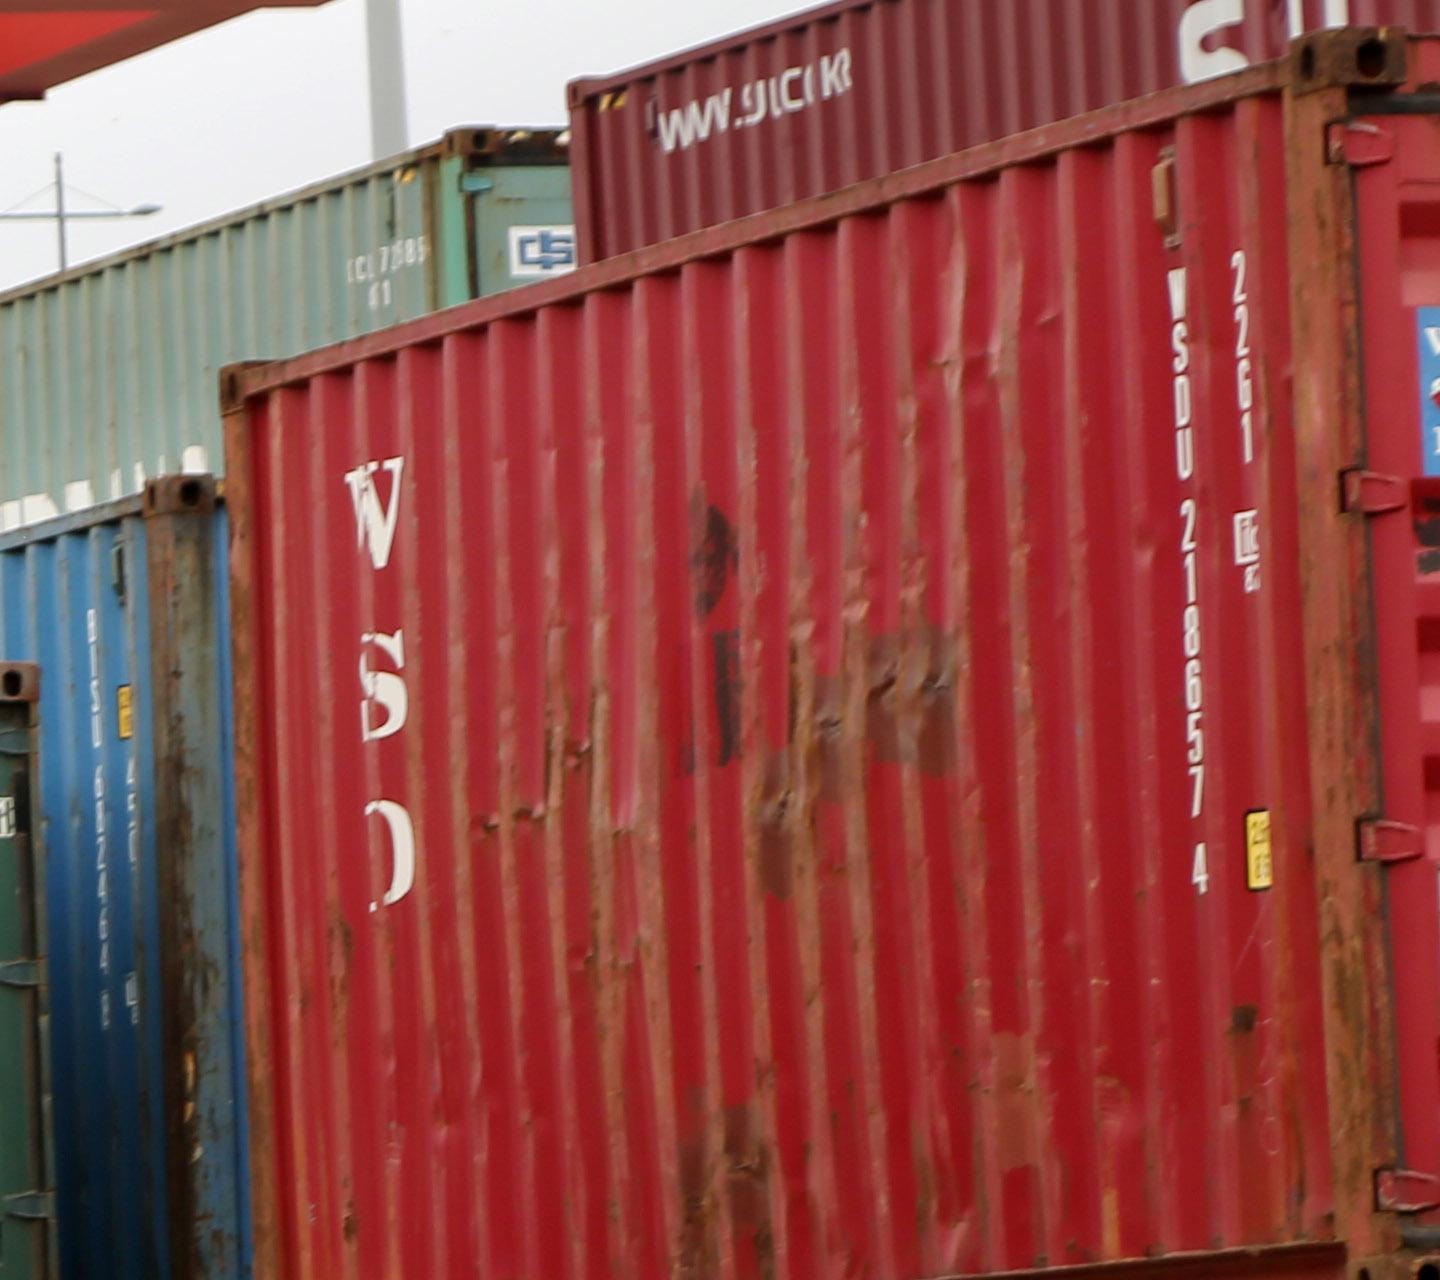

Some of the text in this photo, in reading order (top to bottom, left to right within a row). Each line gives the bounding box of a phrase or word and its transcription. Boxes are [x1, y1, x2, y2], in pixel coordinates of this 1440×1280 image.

[1229, 250, 1253, 464] 22G1
[1168, 268, 1209, 897] WSDU 218657 4
